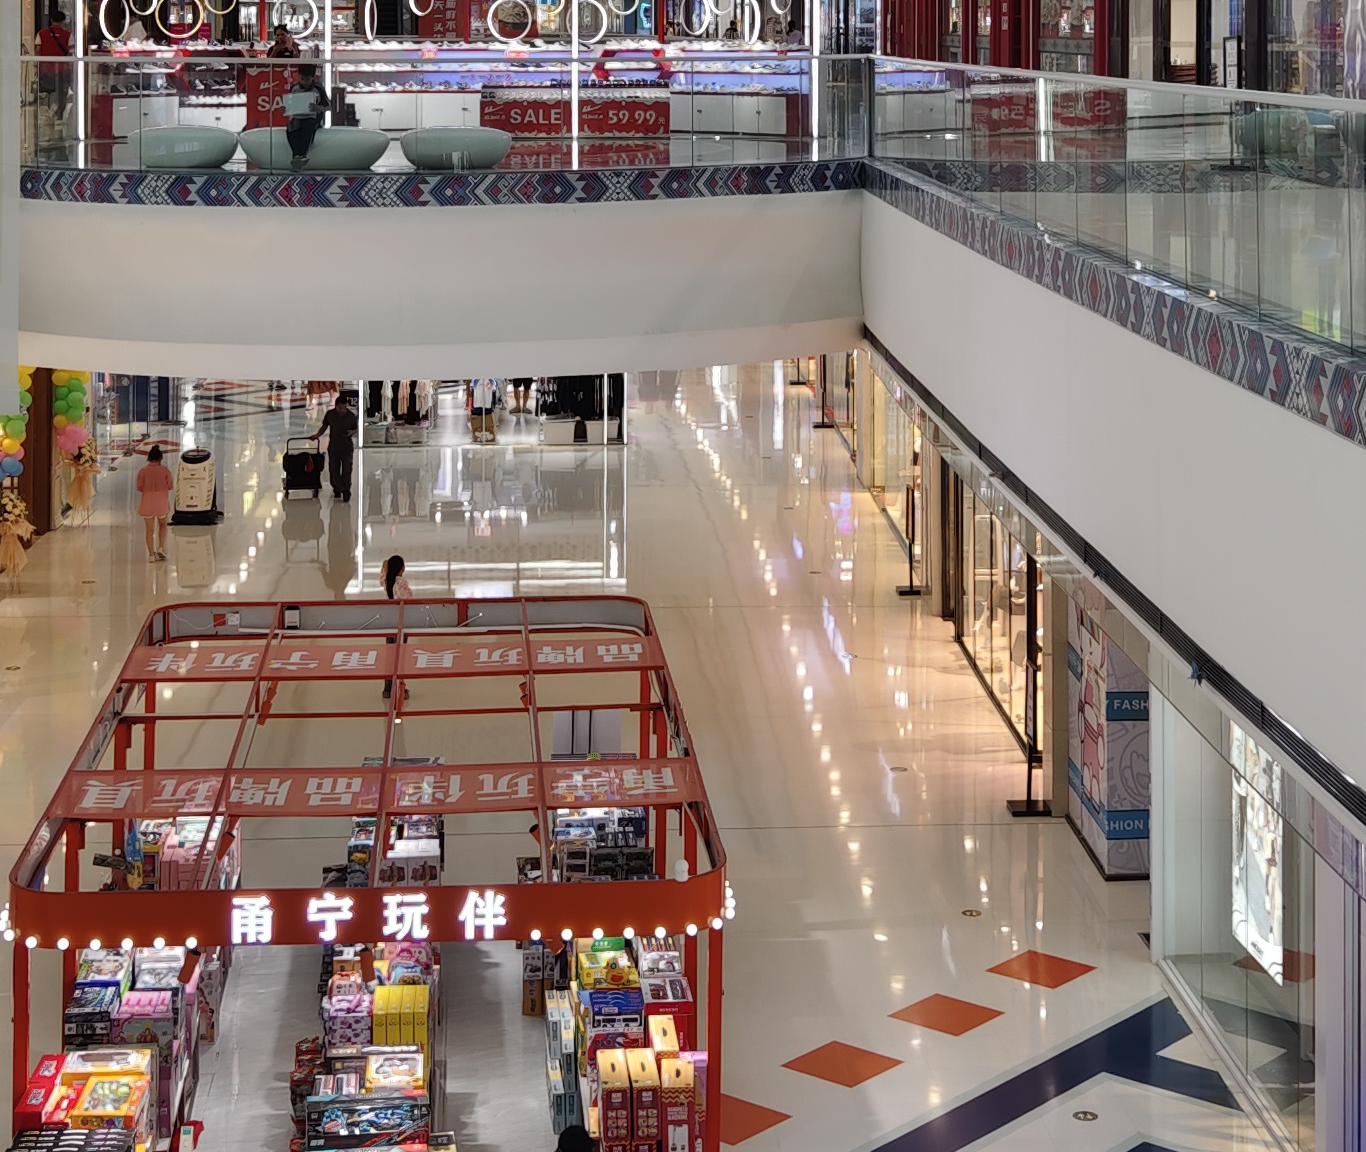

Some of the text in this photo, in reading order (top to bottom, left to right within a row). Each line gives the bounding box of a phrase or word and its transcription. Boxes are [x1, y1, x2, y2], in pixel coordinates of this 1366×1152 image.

[509, 108, 562, 125] SALE
[231, 889, 508, 946] 甬宁玩伴
